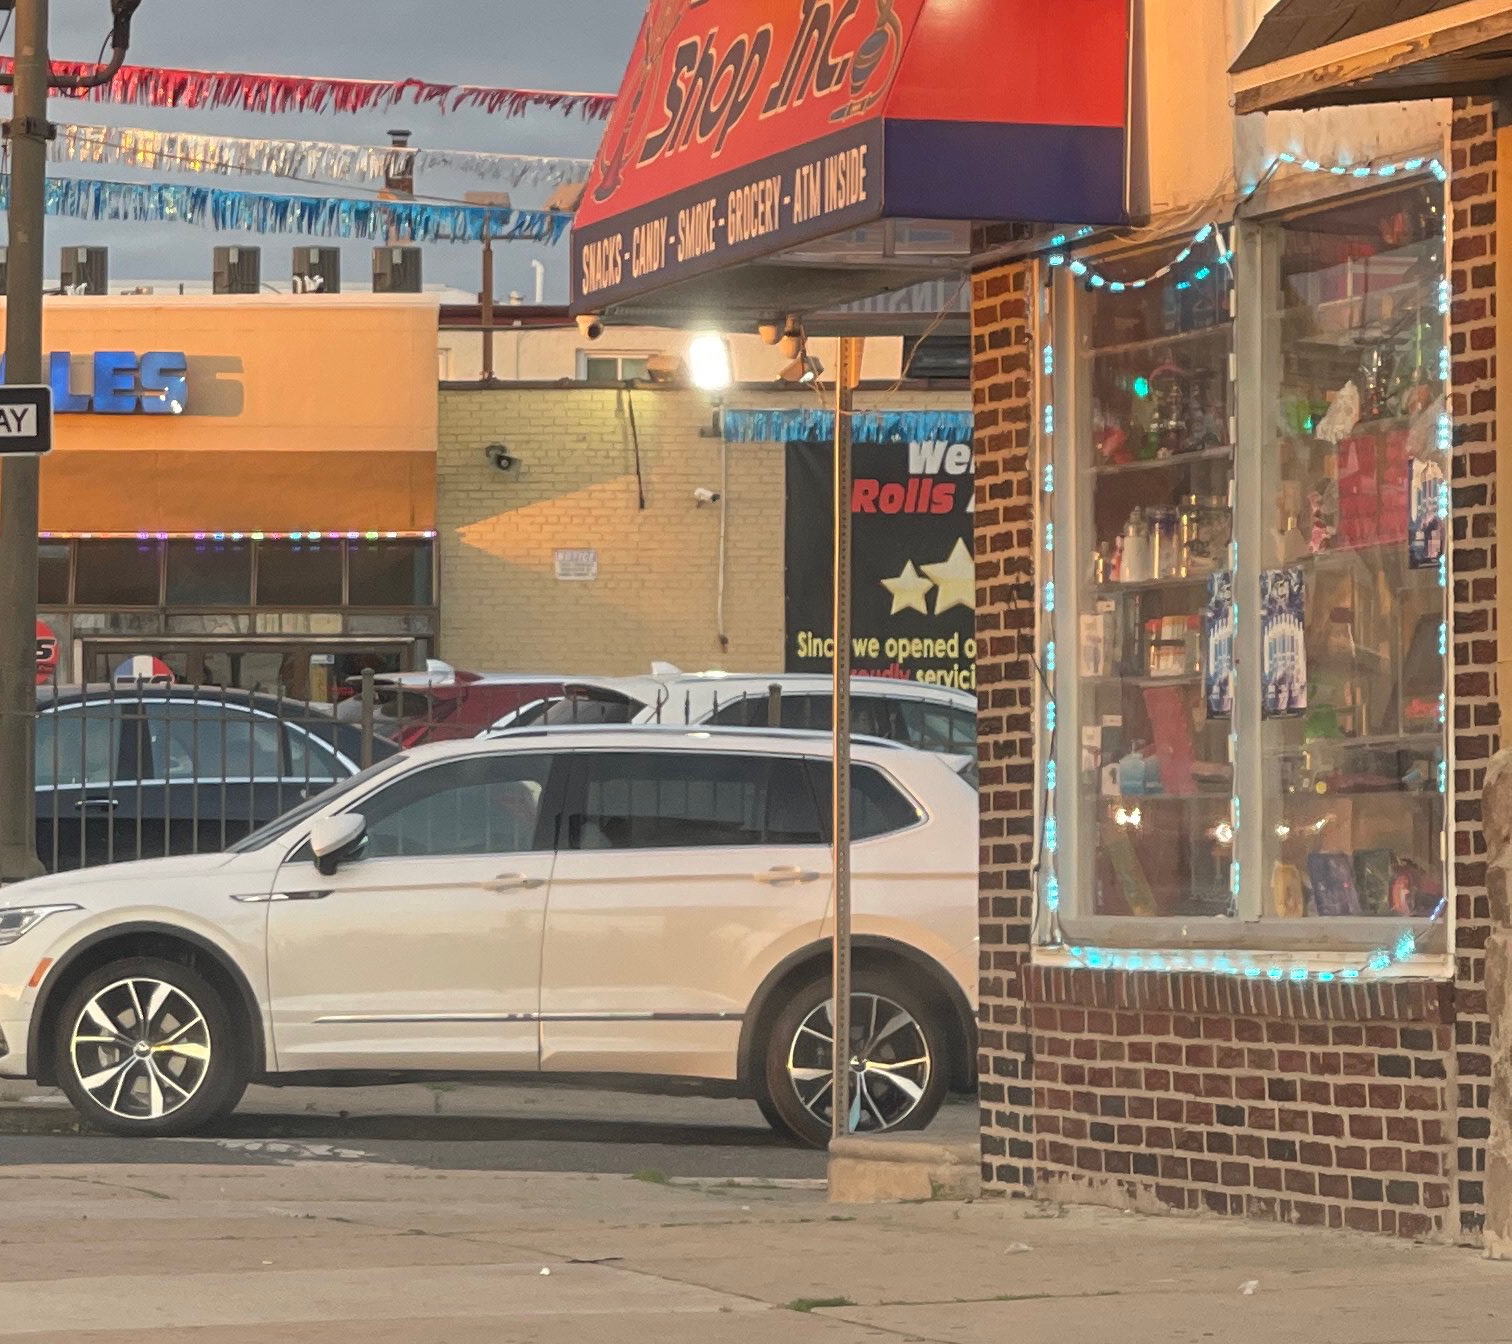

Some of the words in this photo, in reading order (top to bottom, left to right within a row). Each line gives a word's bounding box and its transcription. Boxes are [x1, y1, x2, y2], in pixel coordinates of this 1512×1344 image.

[636, 22, 775, 170] Shop
[582, 232, 623, 296] SNACKS
[631, 216, 669, 278] CANDY
[677, 198, 717, 263] SMOKE
[727, 174, 782, 246] GROCERY
[793, 160, 822, 225] ATM
[824, 144, 868, 214] INSIDE
[908, 440, 975, 476] We
[850, 477, 957, 514] Rolls
[796, 630, 835, 659] Sinc
[852, 637, 880, 657] we
[884, 631, 960, 661] opened
[915, 663, 977, 691] servici
